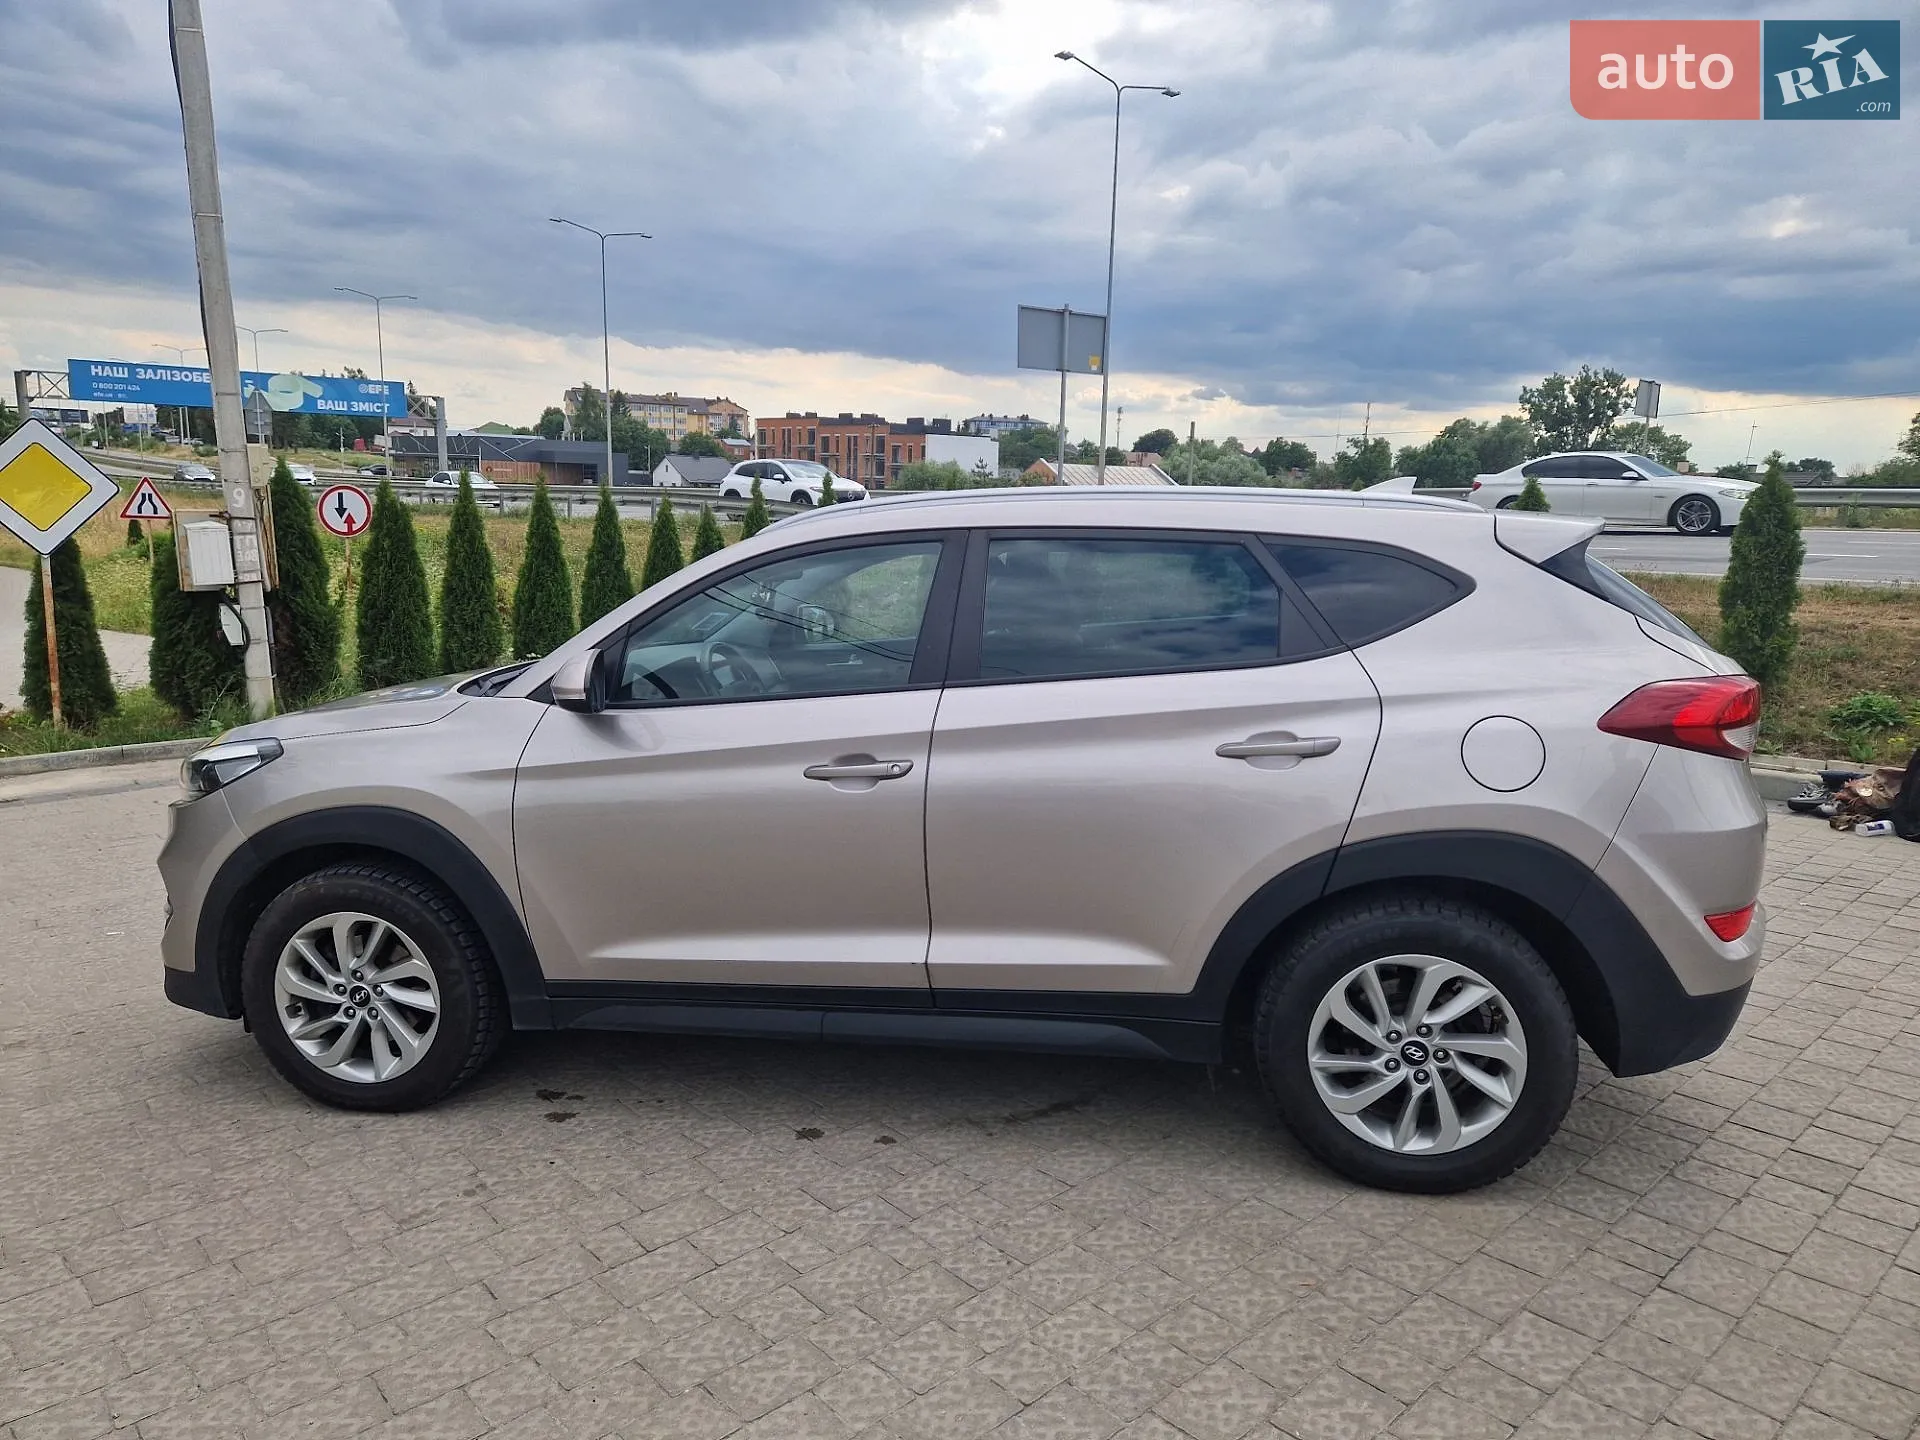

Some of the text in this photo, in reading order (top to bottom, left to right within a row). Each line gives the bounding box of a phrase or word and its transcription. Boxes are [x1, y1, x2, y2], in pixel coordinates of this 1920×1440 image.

[90, 365, 213, 383] НАШ ЗАЛІЗОБЕ
[316, 399, 390, 413] ВАШ ЗМІСТ
[231, 487, 246, 508] 9
